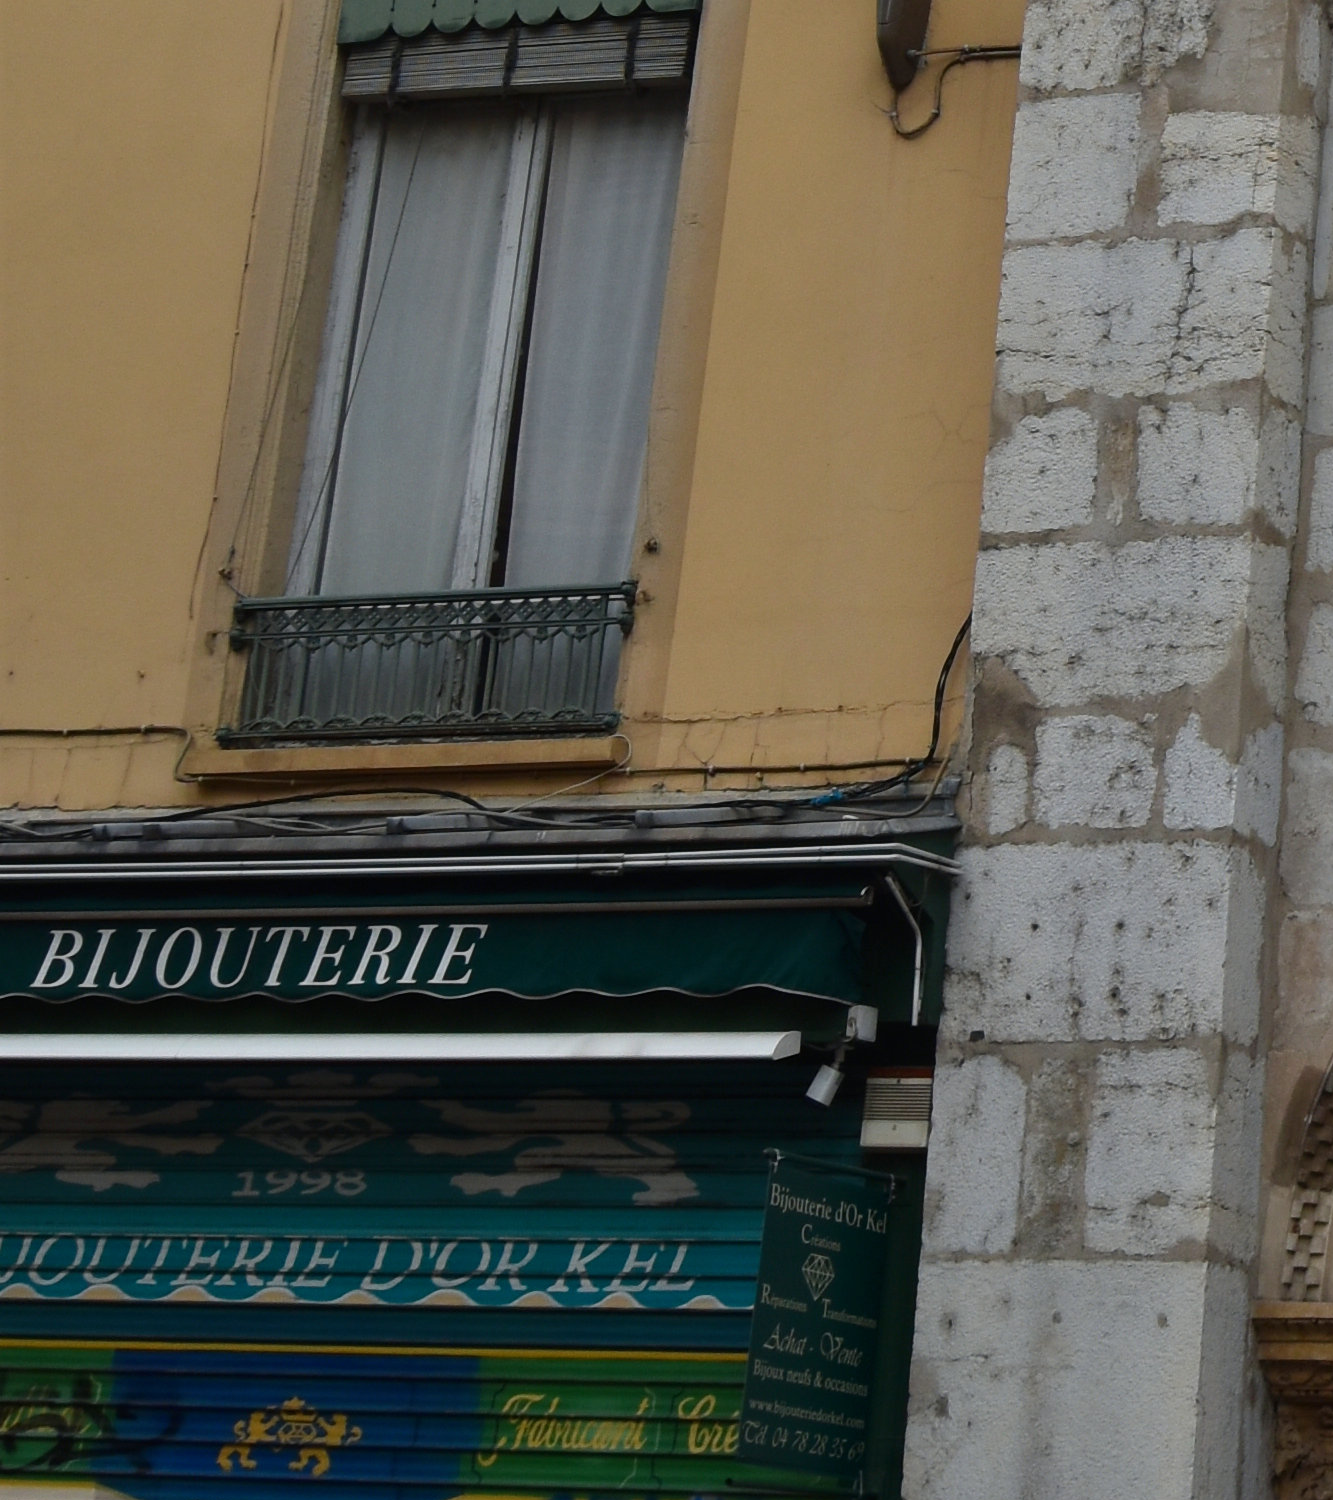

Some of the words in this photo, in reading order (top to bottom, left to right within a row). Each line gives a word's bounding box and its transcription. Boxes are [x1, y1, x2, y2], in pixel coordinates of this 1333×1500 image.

[29, 923, 489, 990] BIJOUTERIE
[231, 1169, 367, 1197] 1998
[770, 1183, 832, 1220] Bijouterie
[835, 1201, 863, 1228] d'Or
[866, 1208, 887, 1234] Kel
[801, 1224, 841, 1252] Créations
[0, 1232, 349, 1288] JOUTERIE
[361, 1233, 539, 1291] D'OR
[547, 1236, 697, 1293] KEL
[763, 1323, 807, 1356] Achat
[820, 1332, 863, 1367] Vente
[753, 1359, 784, 1383] Bijoux
[787, 1369, 811, 1387] neufs
[812, 1372, 823, 1388] &
[824, 1375, 868, 1397] occasions
[749, 1399, 865, 1429] www.bijouteriedorkel.com
[772, 1427, 789, 1448] 04
[792, 1430, 809, 1453] 78
[808, 1434, 829, 1455] 28
[829, 1437, 847, 1459] 35
[848, 1440, 865, 1463] 69
